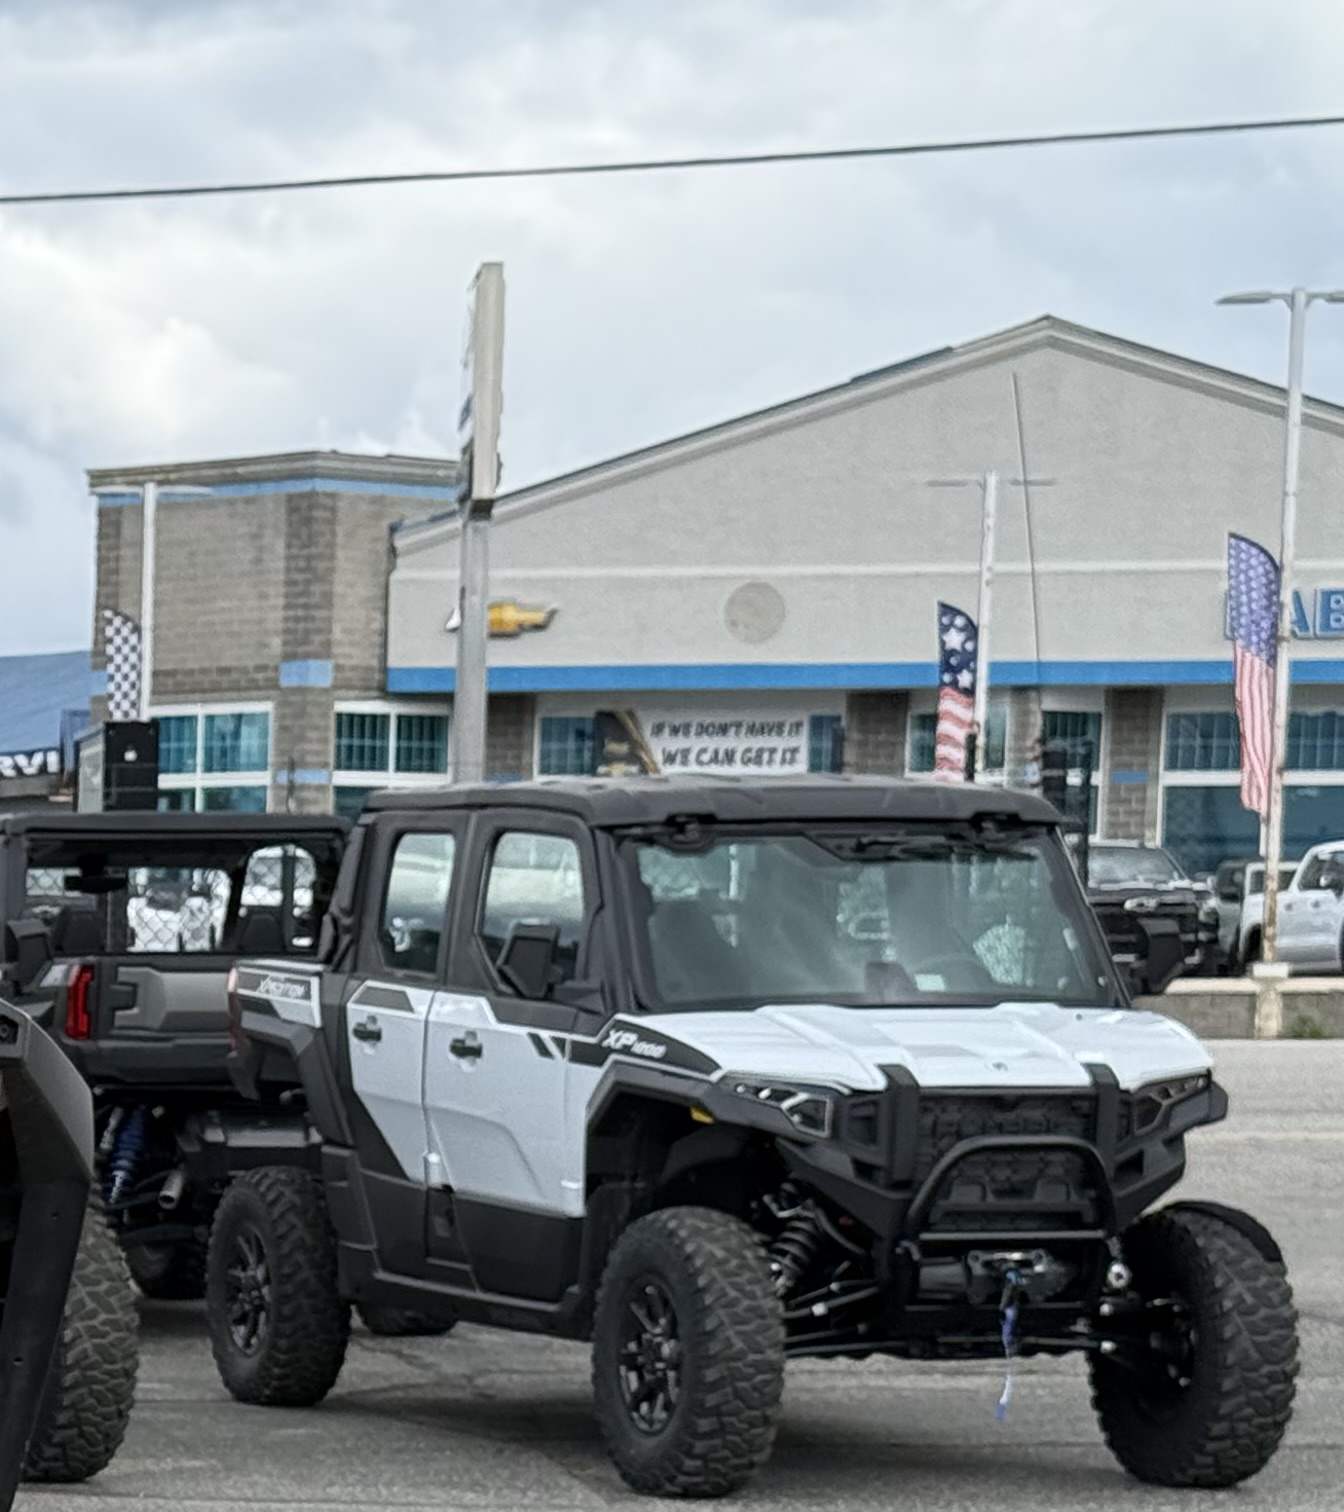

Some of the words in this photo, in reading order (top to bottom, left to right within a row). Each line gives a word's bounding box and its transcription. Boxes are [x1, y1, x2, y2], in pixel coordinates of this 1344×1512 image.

[650, 720, 665, 738] IF
[668, 720, 692, 738] WE
[693, 720, 743, 738] DON'T
[744, 720, 787, 738] HAVE
[787, 720, 805, 738] IT
[662, 746, 693, 767] WE
[694, 746, 739, 767] CAN
[740, 746, 778, 767] GET
[778, 746, 801, 767] IT
[600, 1029, 639, 1050] XP
